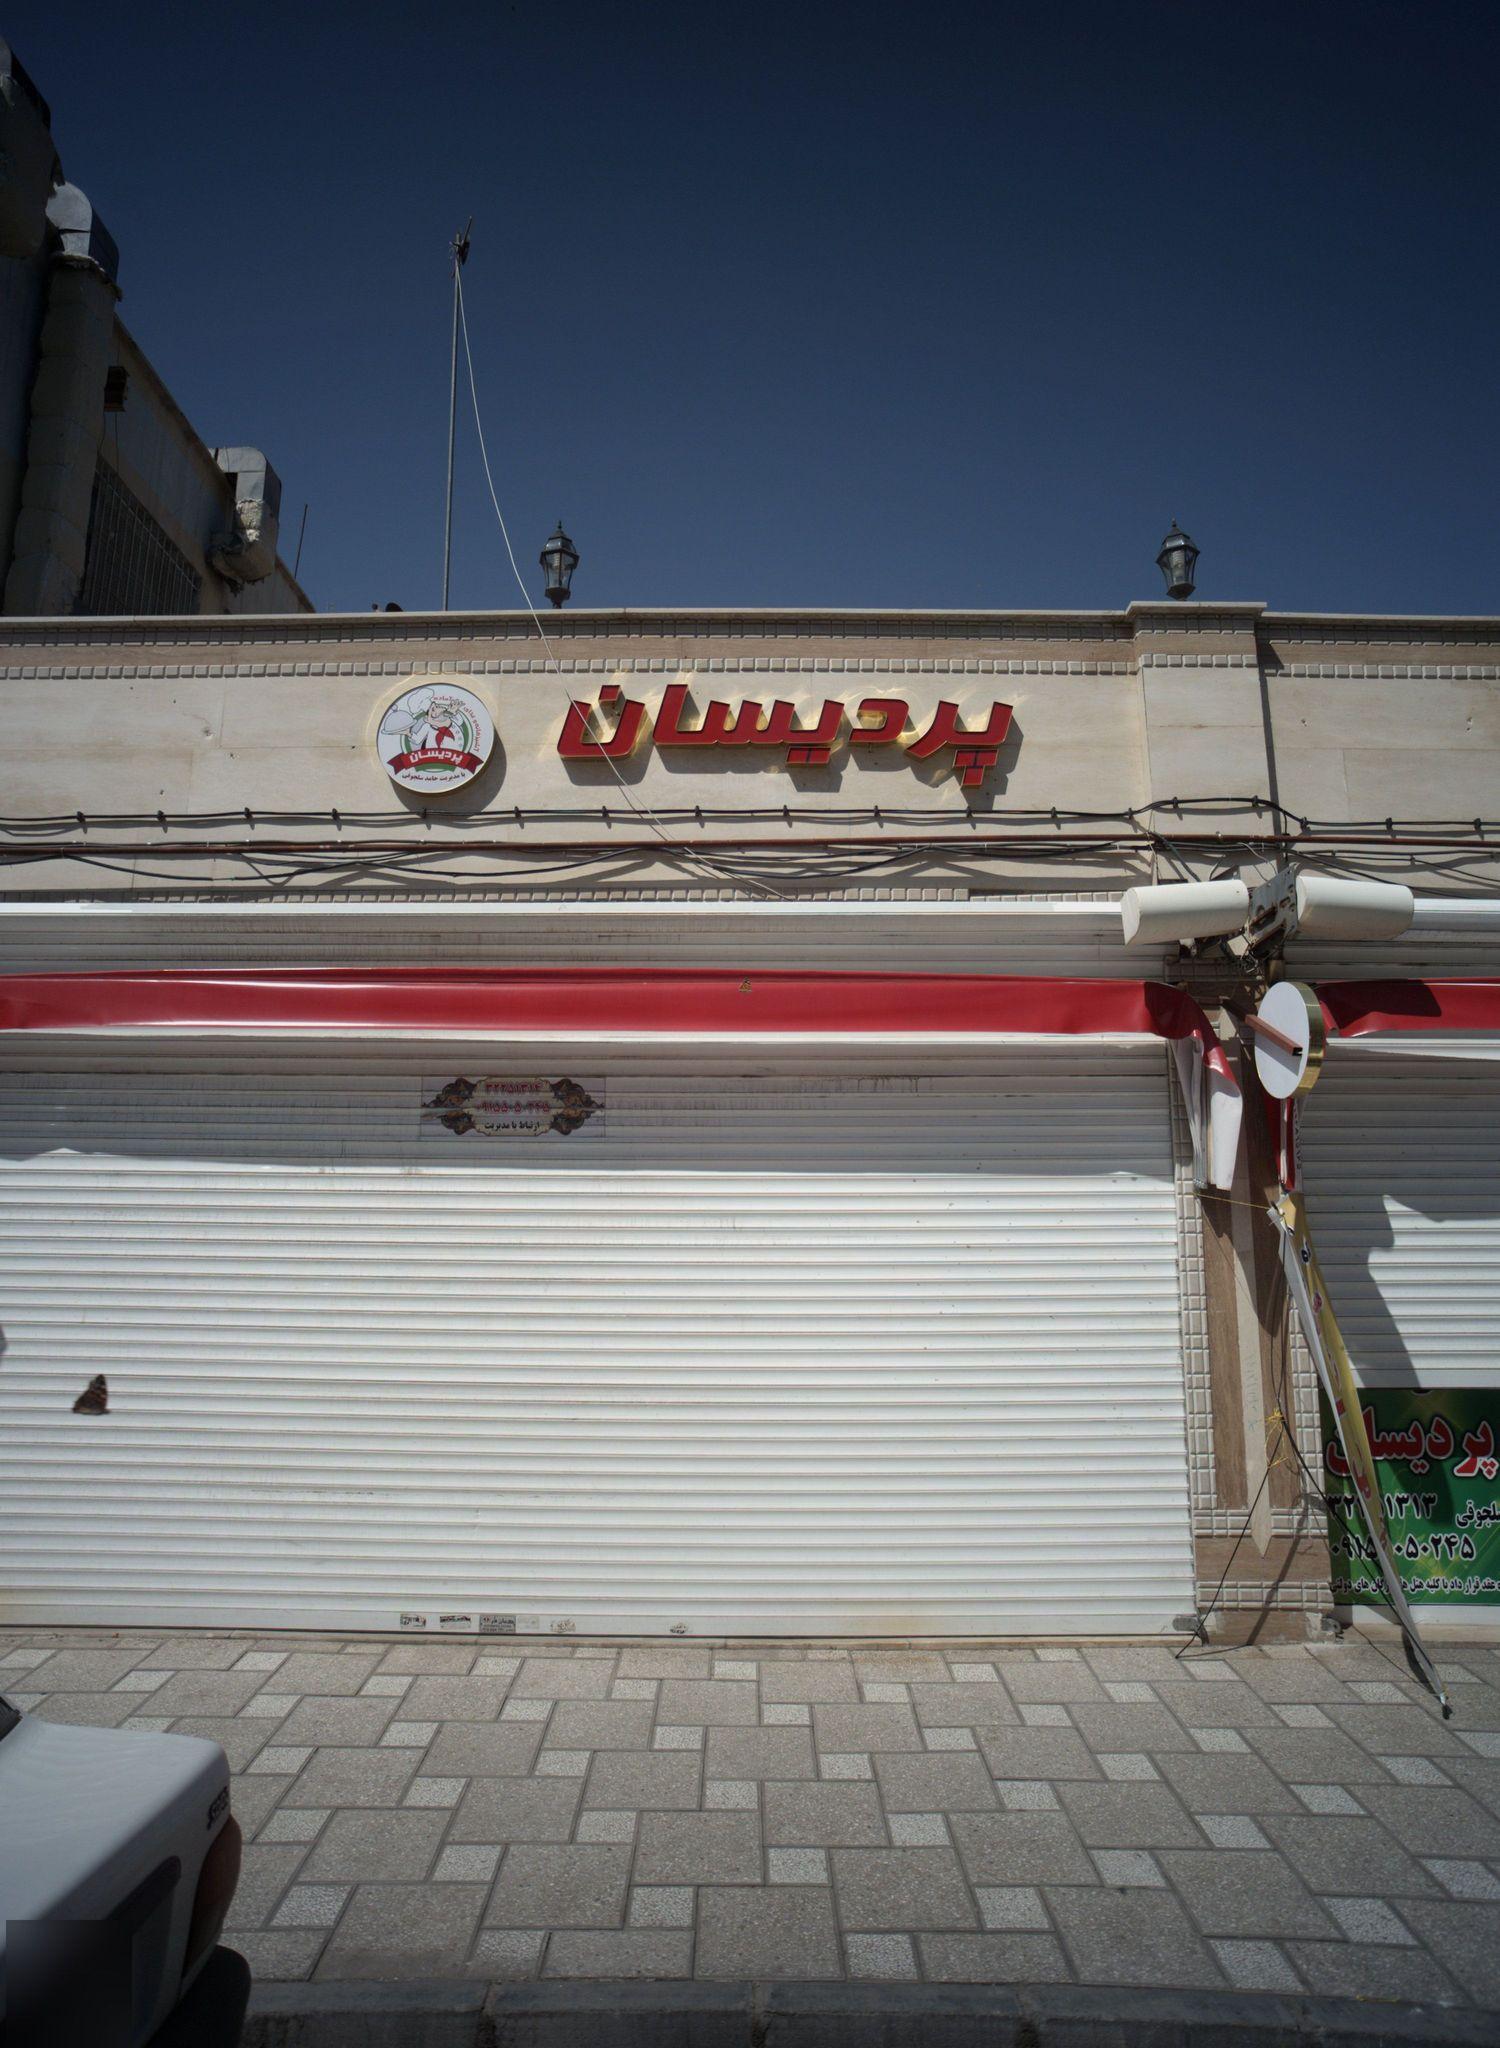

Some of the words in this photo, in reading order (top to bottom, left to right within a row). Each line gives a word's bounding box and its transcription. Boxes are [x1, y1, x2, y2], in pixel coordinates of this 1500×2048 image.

[557, 683, 1014, 787] پردیسان
[409, 750, 463, 765] پردیسان
[1332, 1533, 1476, 1562] ۰۹۱۵۰۵۰۲۴۵
